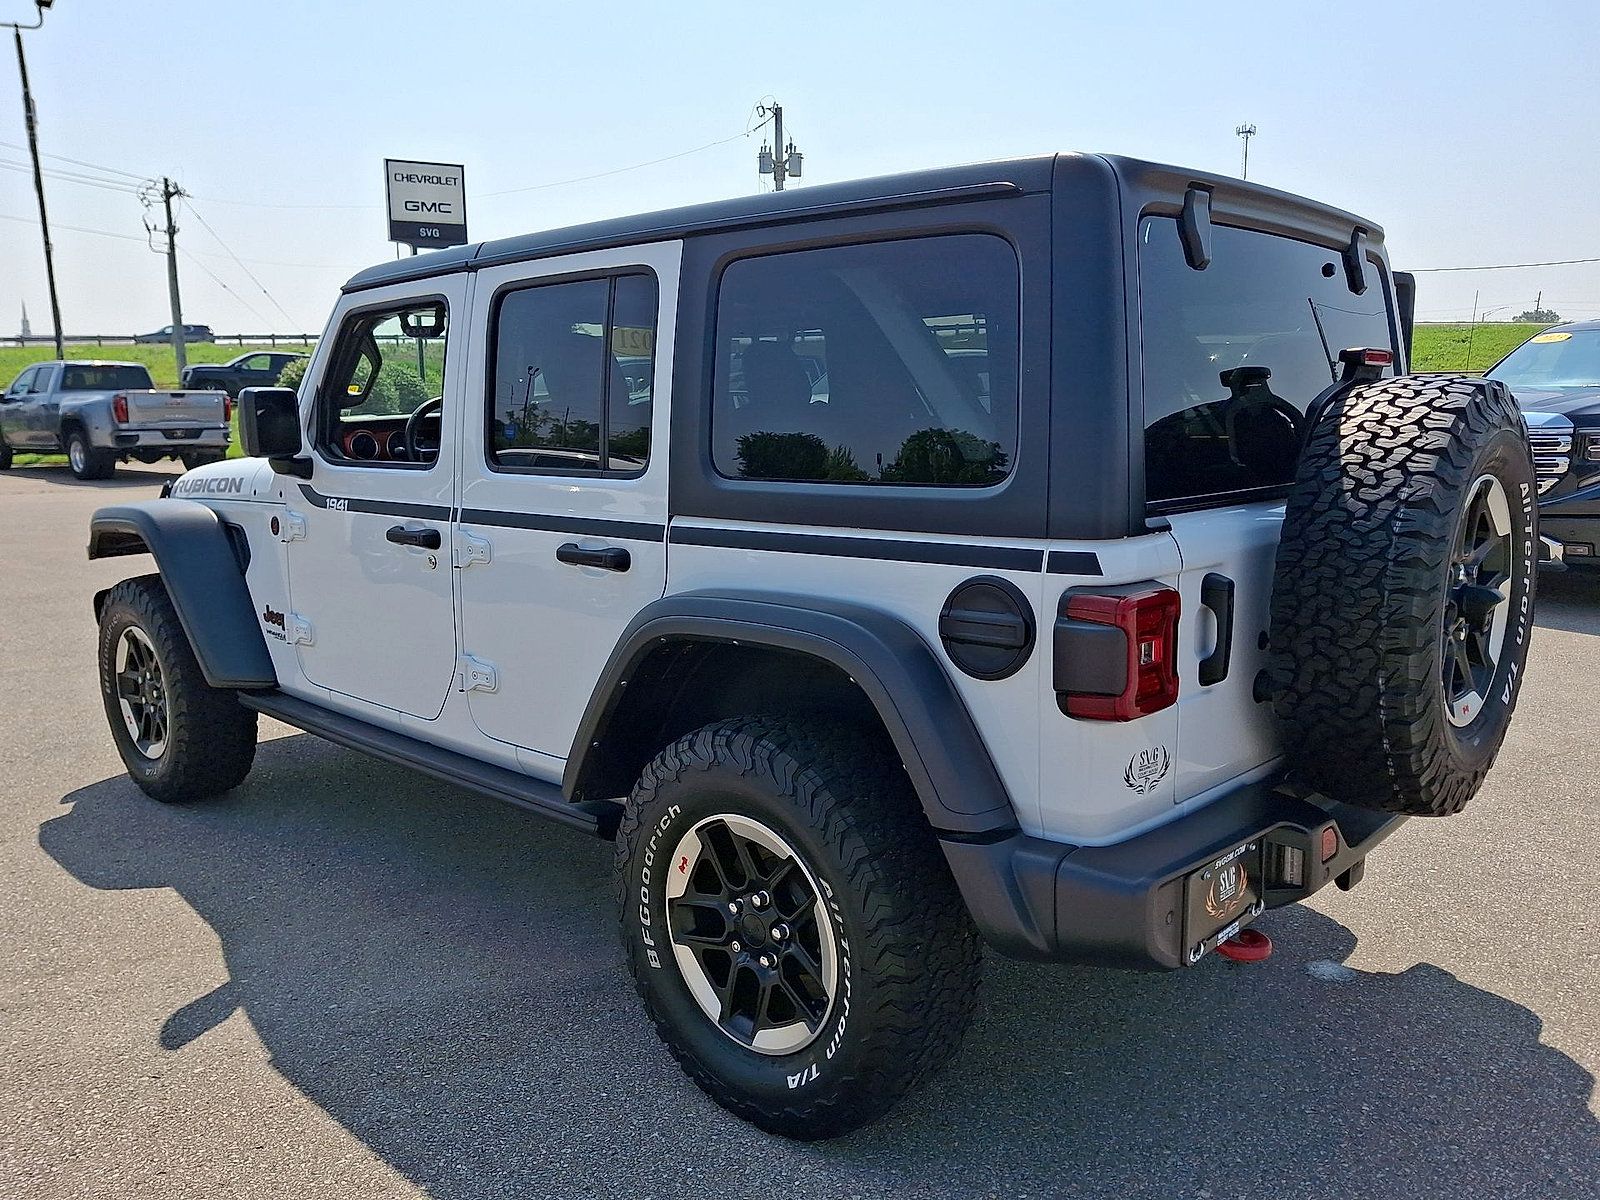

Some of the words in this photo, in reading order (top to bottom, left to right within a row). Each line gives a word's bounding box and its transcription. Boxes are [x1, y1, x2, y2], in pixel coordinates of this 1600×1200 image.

[394, 173, 458, 186] CHEVROLET
[404, 200, 452, 213] GMC
[419, 227, 440, 237] SVG
[174, 477, 244, 494] RUBICON
[325, 498, 349, 511] 1941
[1516, 482, 1534, 646] All-Terrain
[263, 604, 286, 631] Jeep
[1501, 661, 1519, 705] T/A
[1139, 746, 1159, 765] SVG
[638, 803, 681, 970] BFGoodrich
[1220, 866, 1236, 891] SVG
[818, 876, 851, 1060] All-Terrain
[786, 1062, 821, 1090] T/A
